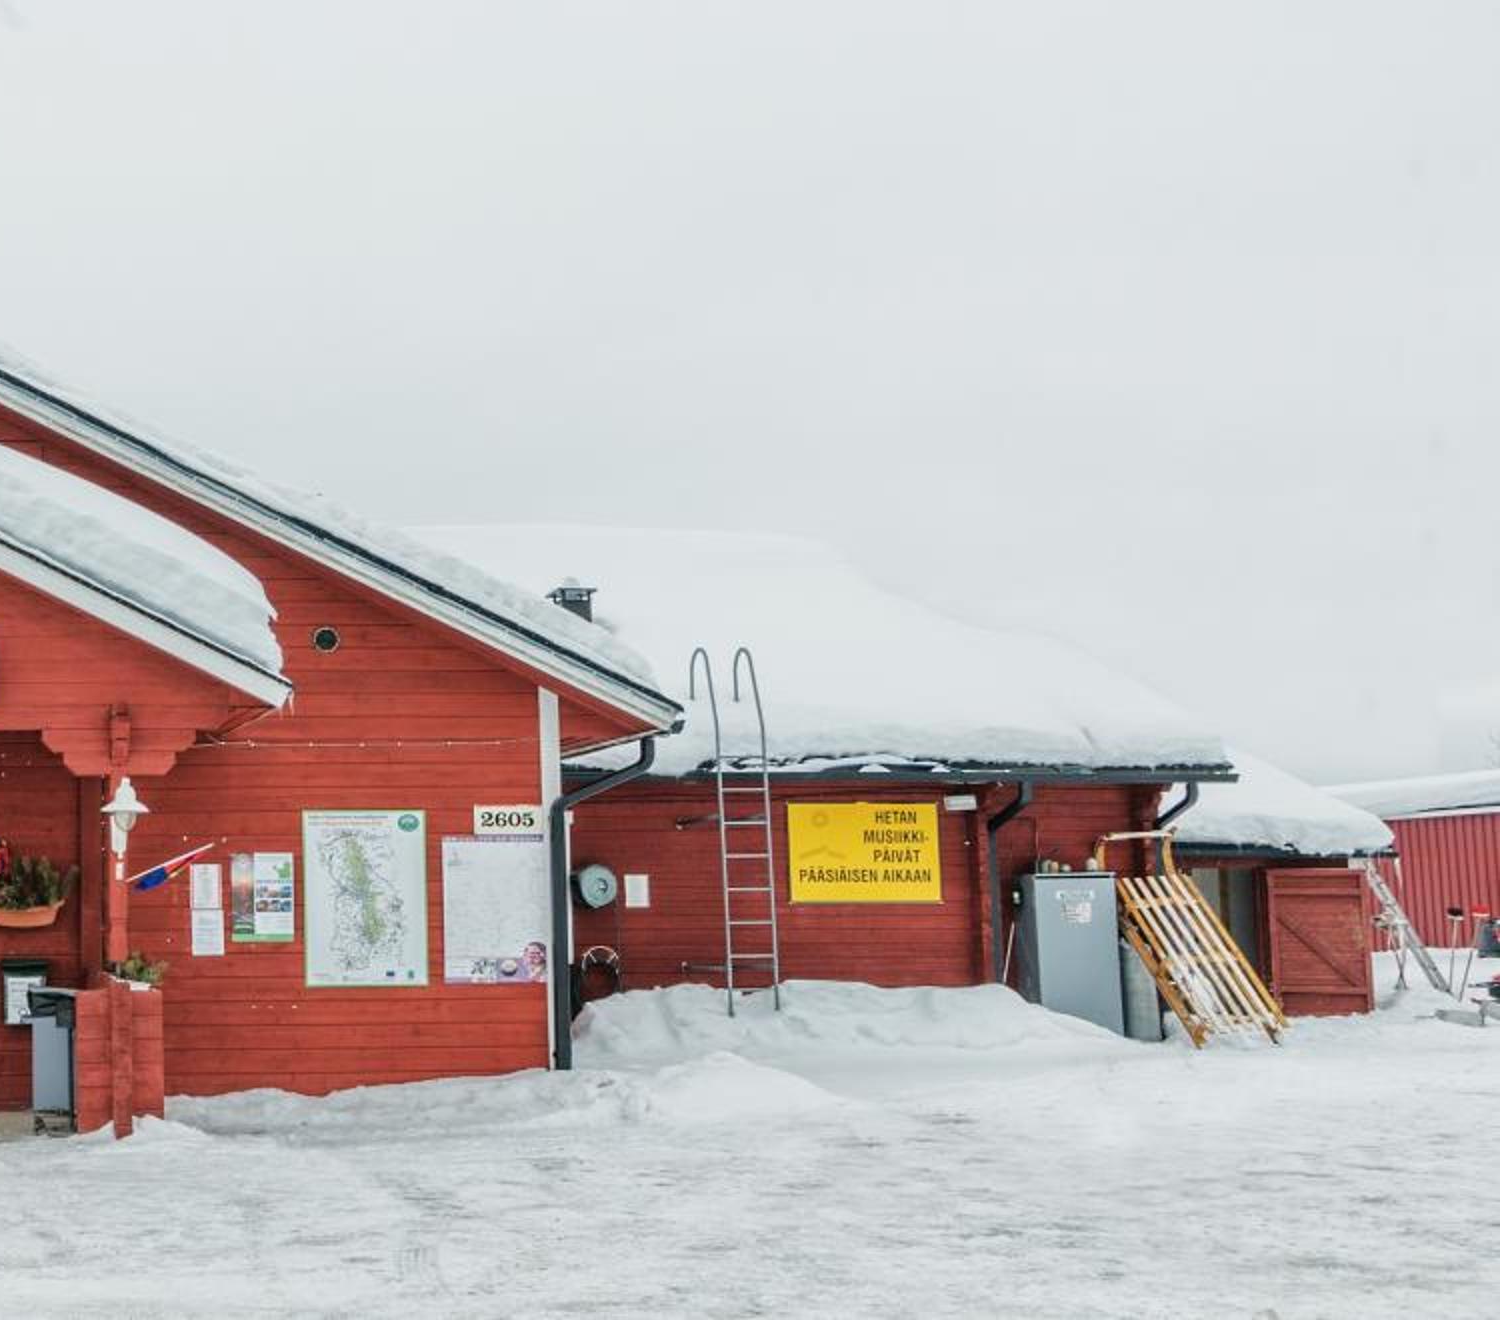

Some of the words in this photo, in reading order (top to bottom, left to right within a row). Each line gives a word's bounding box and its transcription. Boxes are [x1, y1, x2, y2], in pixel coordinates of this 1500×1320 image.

[481, 811, 535, 827] 2605
[875, 810, 917, 824] HETAN
[863, 830, 929, 844] MUSIIKKI-
[873, 847, 921, 863] PÄIVÄT
[799, 866, 878, 883] PÄÄSIÄISEN
[882, 869, 931, 883] AIKAAN
